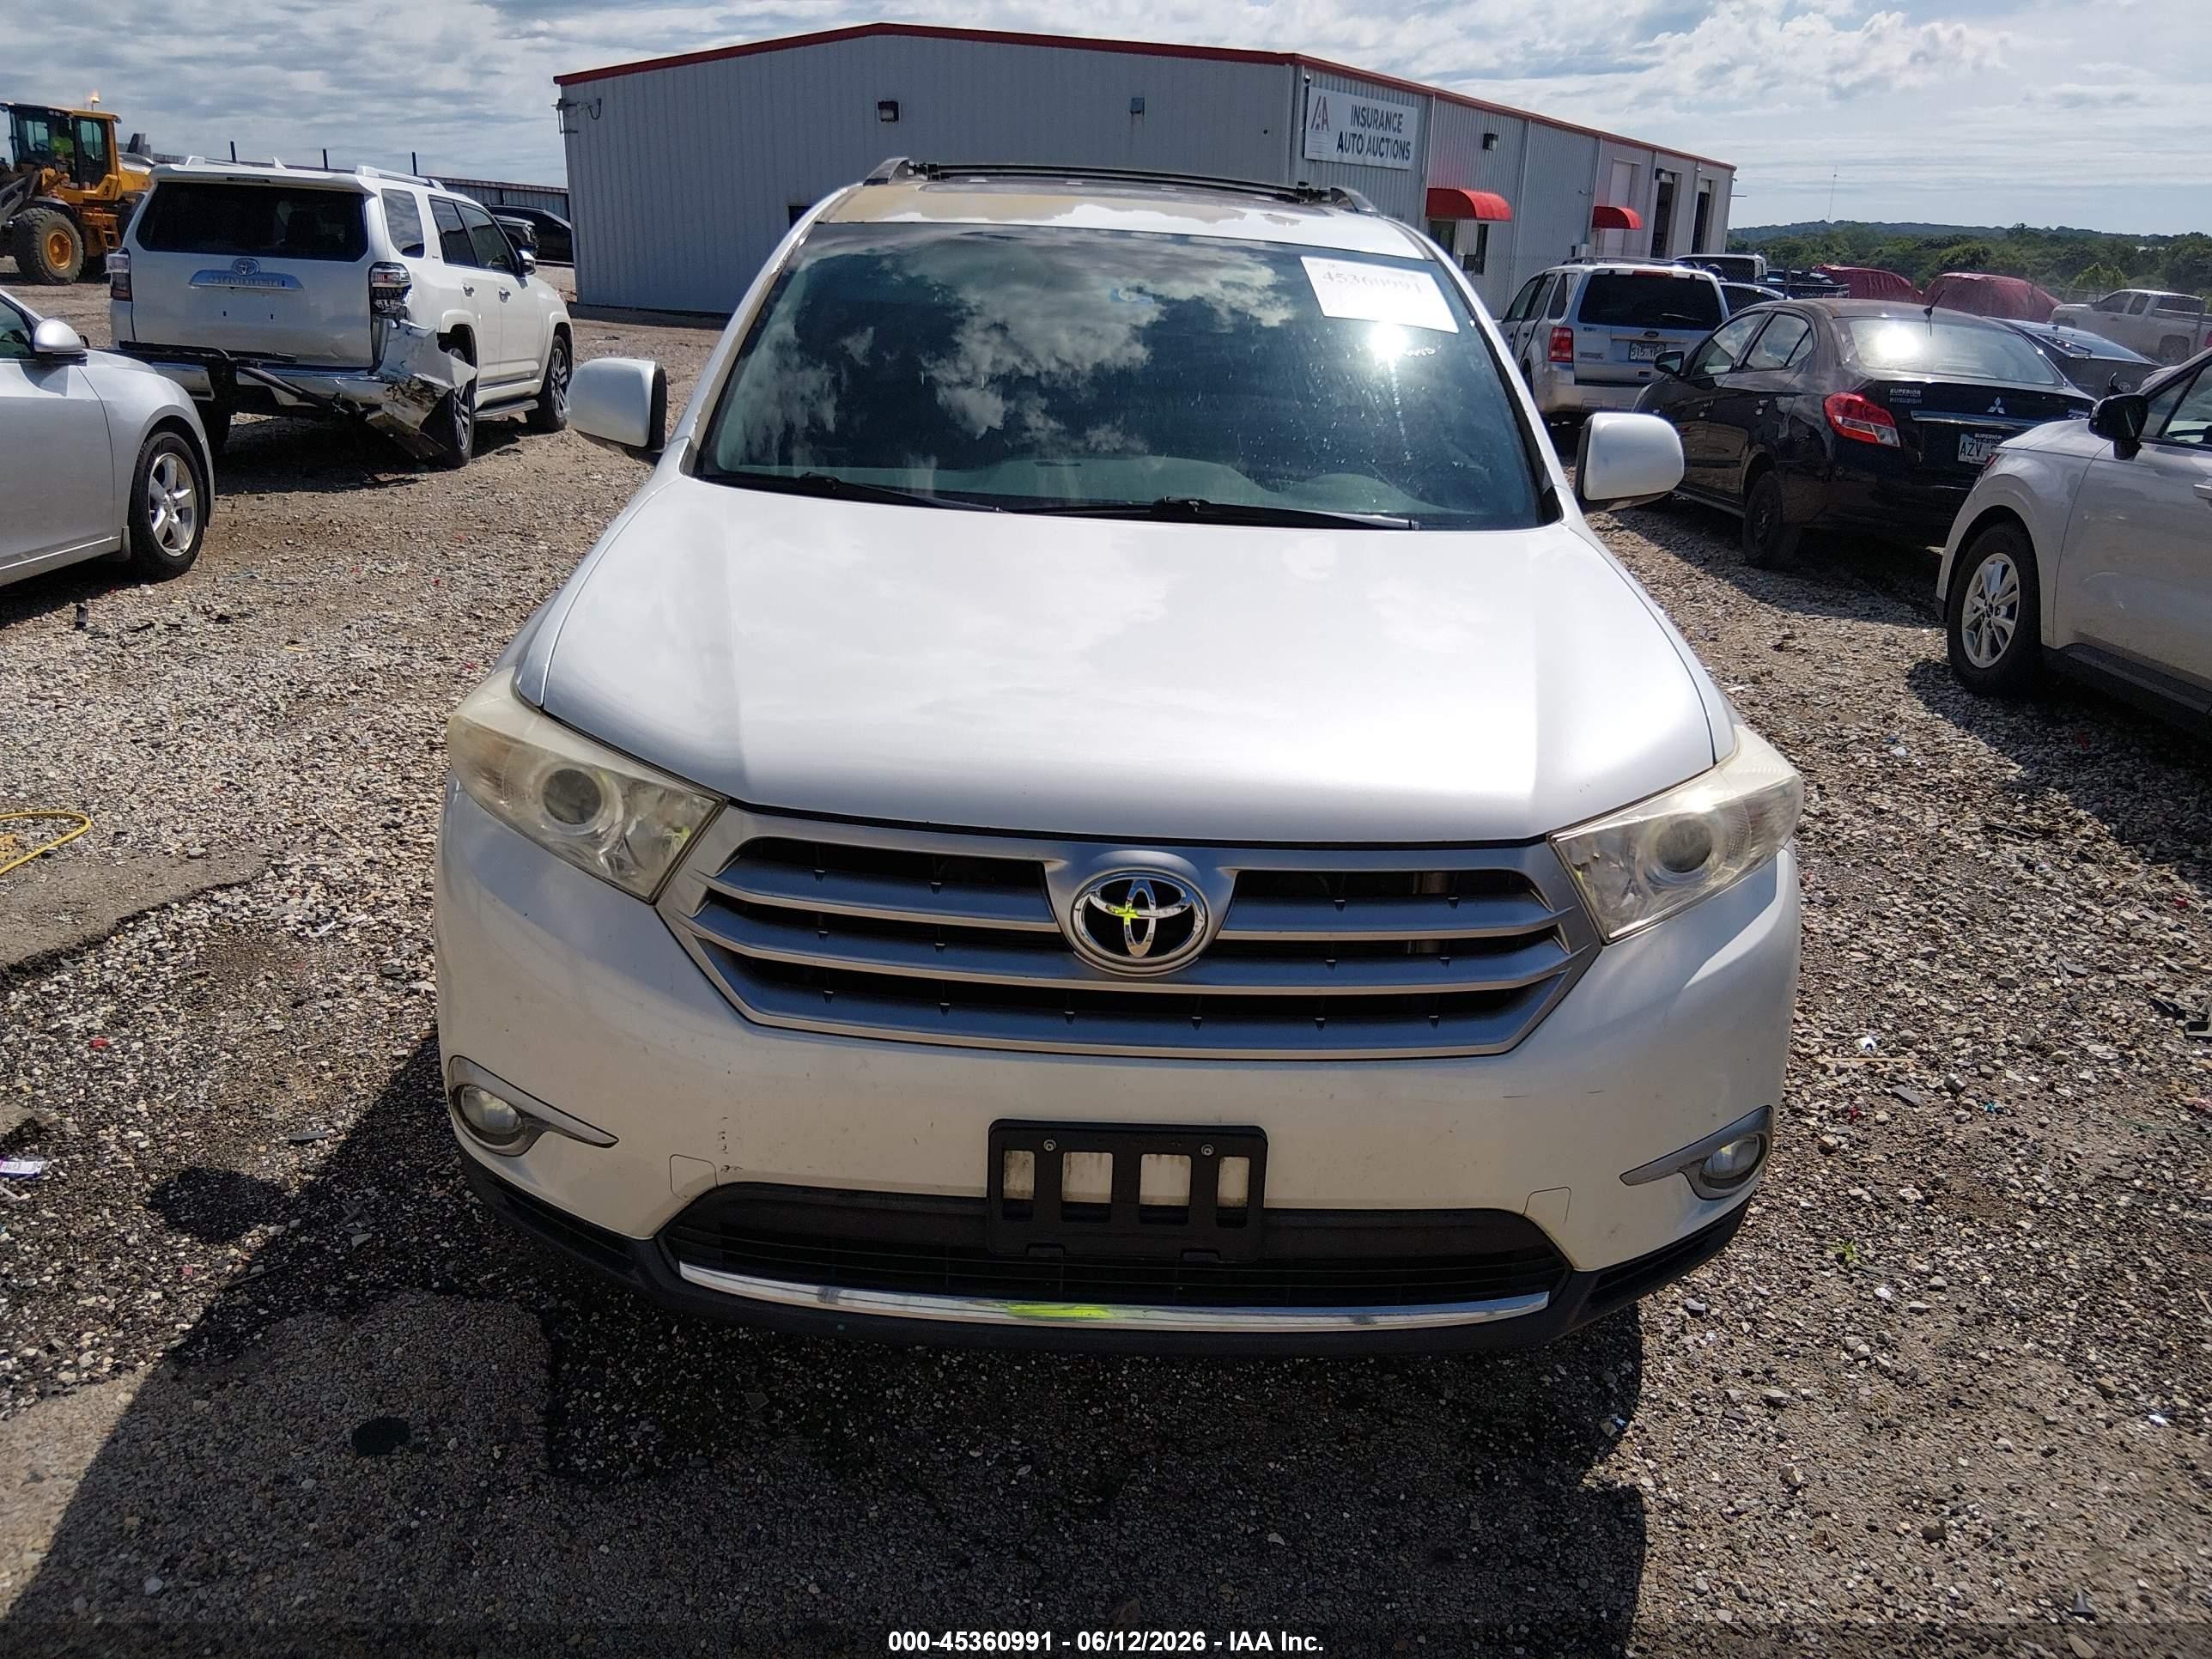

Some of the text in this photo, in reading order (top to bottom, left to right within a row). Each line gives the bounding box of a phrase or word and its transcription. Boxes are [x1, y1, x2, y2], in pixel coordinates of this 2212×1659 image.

[1350, 104, 1404, 134] INSURANCE
[1336, 131, 1364, 155] AUTO
[1366, 135, 1411, 161] AUCTIONS
[1889, 387, 1922, 397] SUPERIOR
